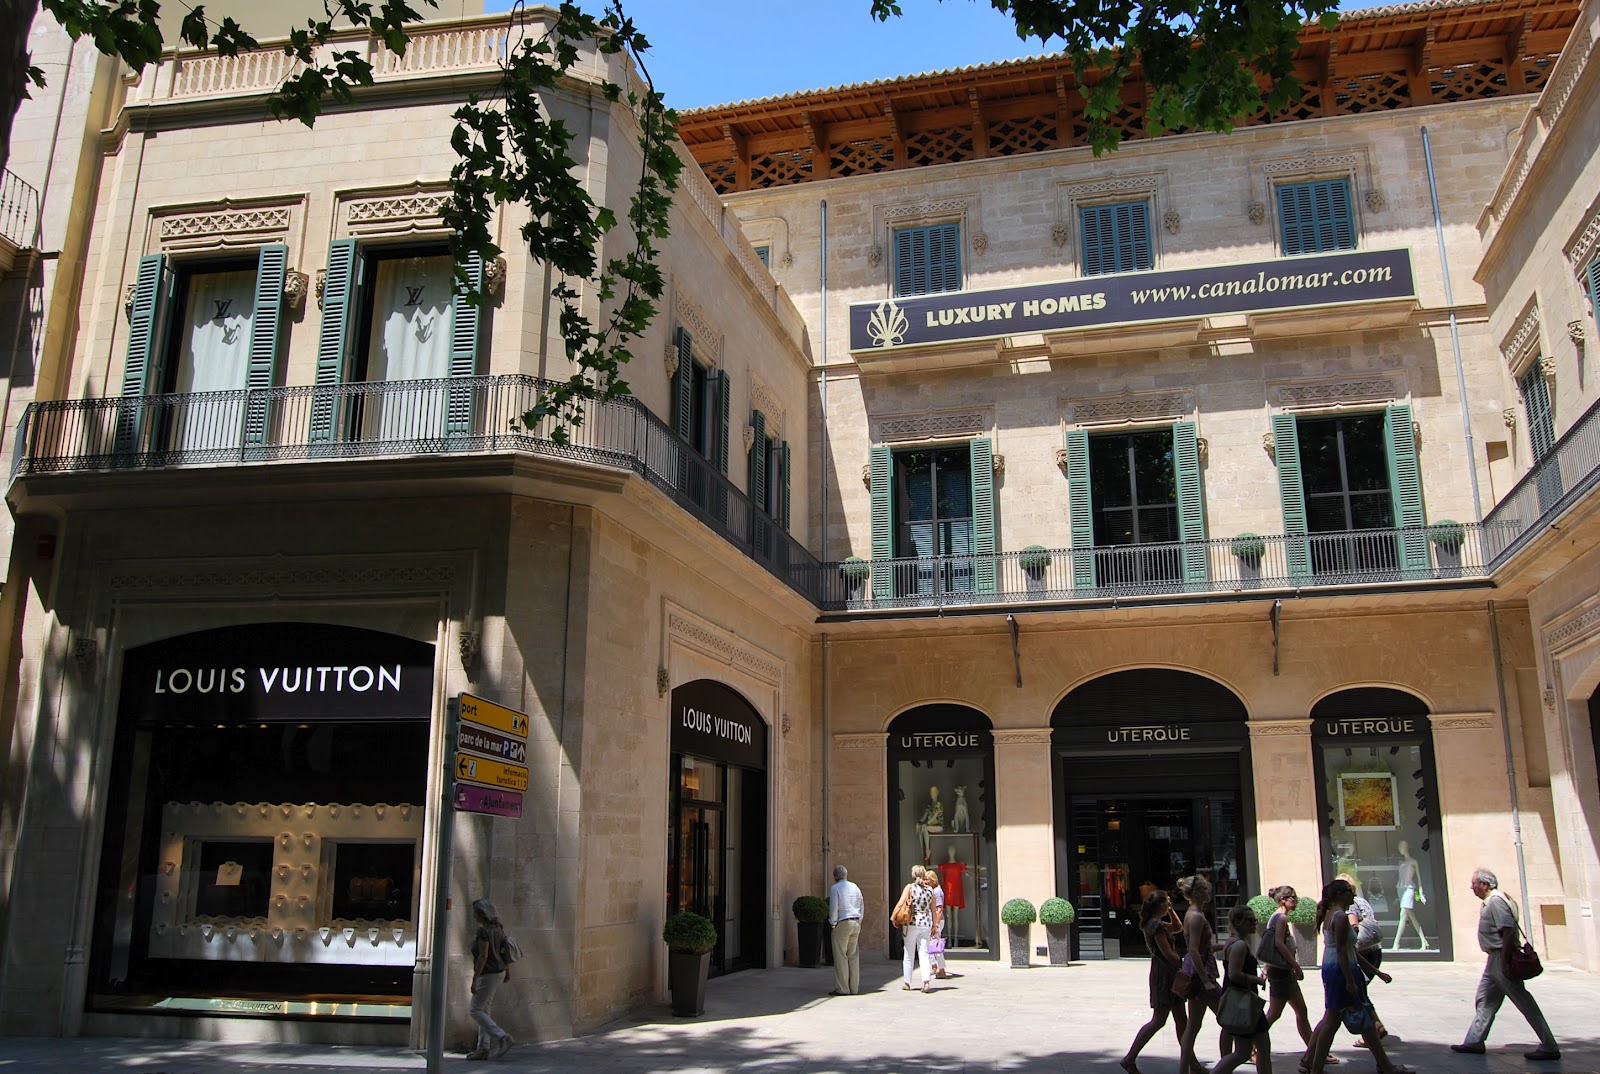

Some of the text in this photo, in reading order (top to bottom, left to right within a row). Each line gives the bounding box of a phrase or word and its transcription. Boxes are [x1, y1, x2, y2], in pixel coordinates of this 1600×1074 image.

[926, 266, 1393, 327] LUXURY HOMES www.canalomar.com
[154, 664, 401, 693] LOUIS VUITTON
[461, 703, 477, 716] port
[683, 706, 752, 745] LOUIS VUITTON
[460, 733, 474, 744] parc
[475, 734, 483, 747] de
[484, 737, 490, 749] la
[490, 742, 502, 752] mar
